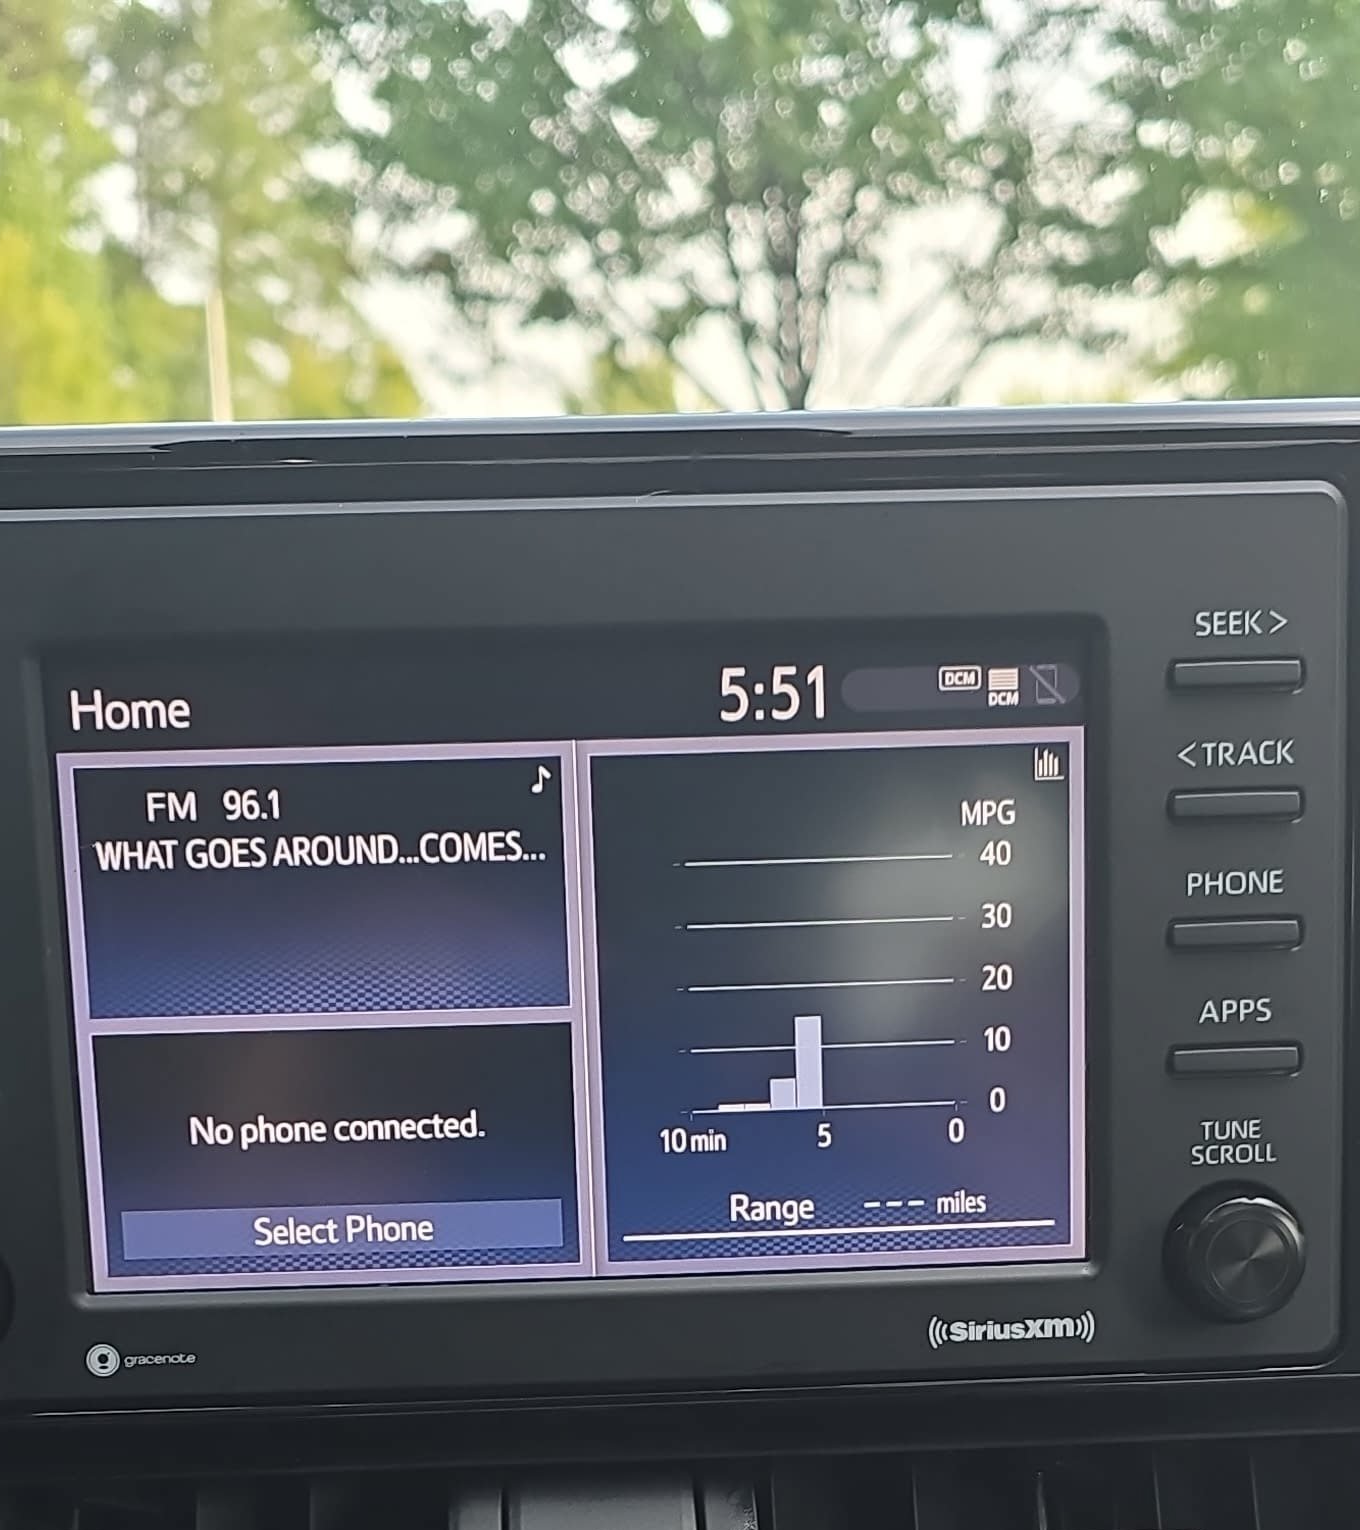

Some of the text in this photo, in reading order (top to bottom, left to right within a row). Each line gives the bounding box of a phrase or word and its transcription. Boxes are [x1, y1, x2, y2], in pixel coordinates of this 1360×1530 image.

[720, 664, 825, 722] 5:51
[944, 671, 977, 689] DCM
[70, 689, 191, 731] Home
[988, 690, 1019, 707] DCM
[146, 789, 280, 822] FM 96.1
[961, 799, 1016, 827] MPG
[92, 839, 179, 871] WHAT
[185, 836, 268, 870] GOES
[979, 839, 1012, 866] 40
[1187, 869, 1284, 897] PHONE
[981, 902, 1012, 929] 30
[982, 964, 1013, 991] 20
[1198, 998, 1272, 1024] APPS
[983, 1025, 1011, 1052] 10
[989, 1087, 1006, 1113] 0
[189, 1109, 486, 1151] No phone connected.
[660, 1127, 727, 1153] 10 min
[817, 1122, 832, 1148] 5
[948, 1117, 965, 1143] 0
[1200, 1119, 1261, 1141] TUNE
[1191, 1143, 1277, 1165] SCROLL
[730, 1193, 815, 1227] Range
[936, 1189, 987, 1214] miles
[253, 1214, 434, 1246] Select Phone
[123, 1353, 196, 1368] gracenote
